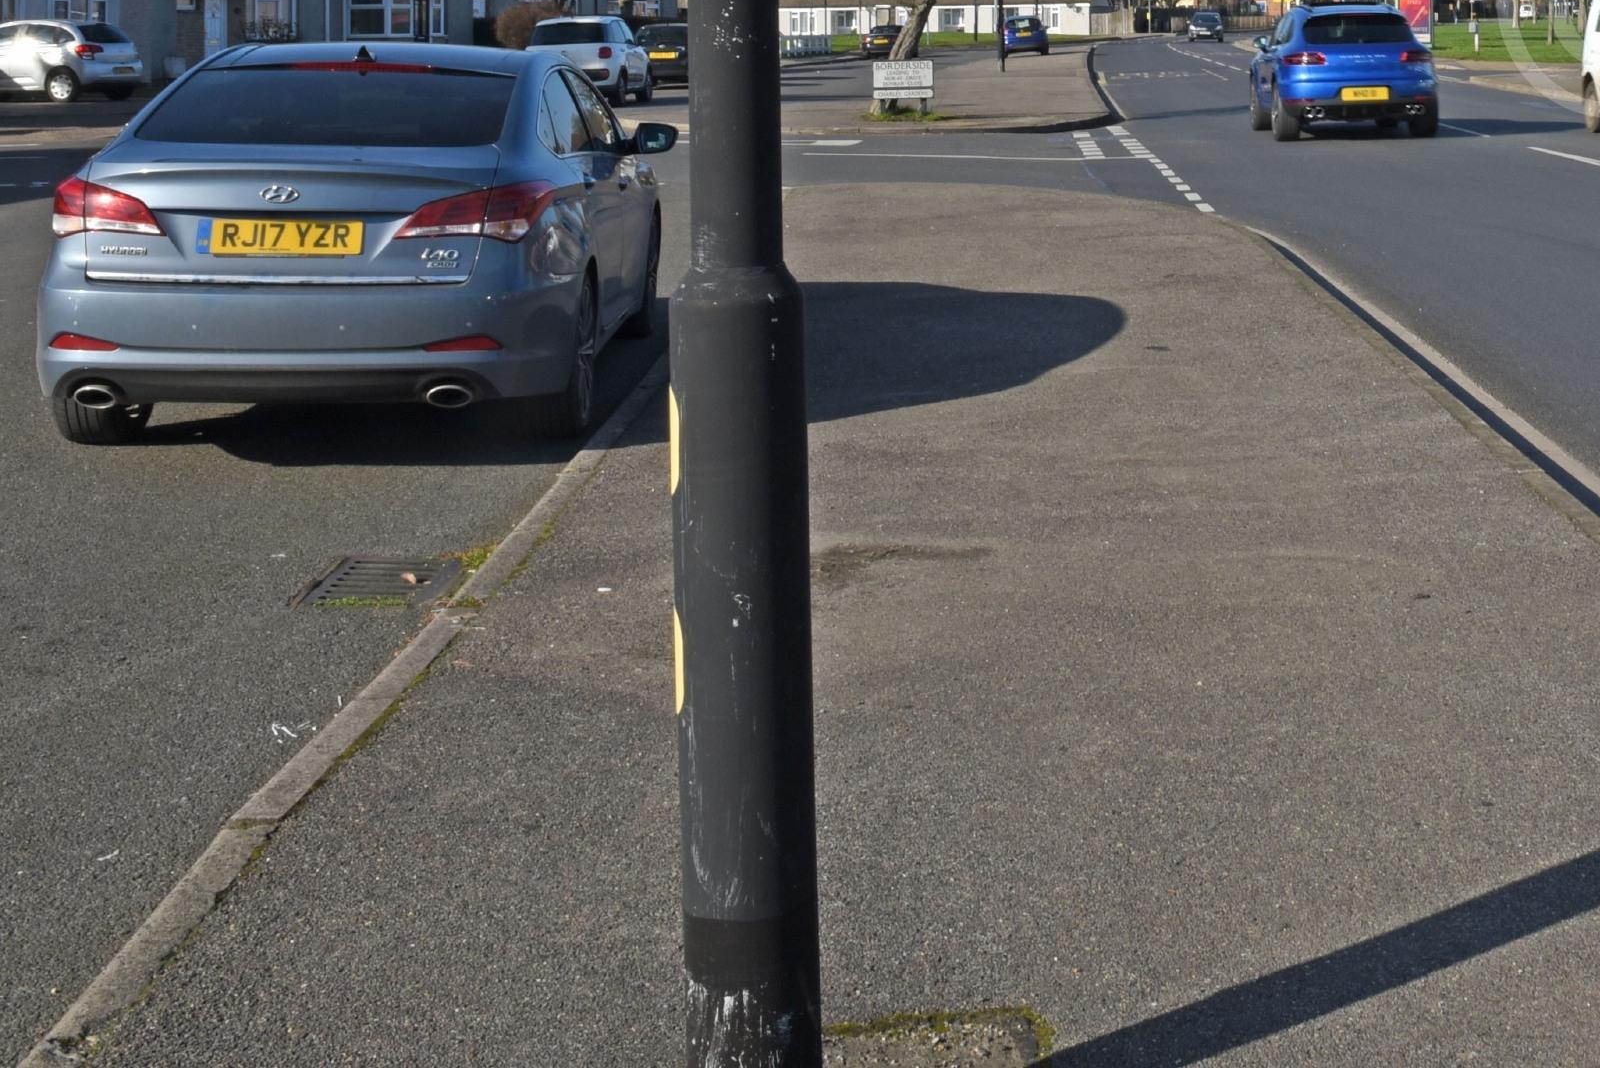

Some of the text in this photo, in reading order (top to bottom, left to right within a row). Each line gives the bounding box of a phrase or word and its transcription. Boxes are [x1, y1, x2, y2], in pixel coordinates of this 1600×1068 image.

[876, 62, 931, 70] BORDERSIDE
[222, 223, 350, 249] RJ17 YZR
[100, 245, 148, 256] HYUNDAI
